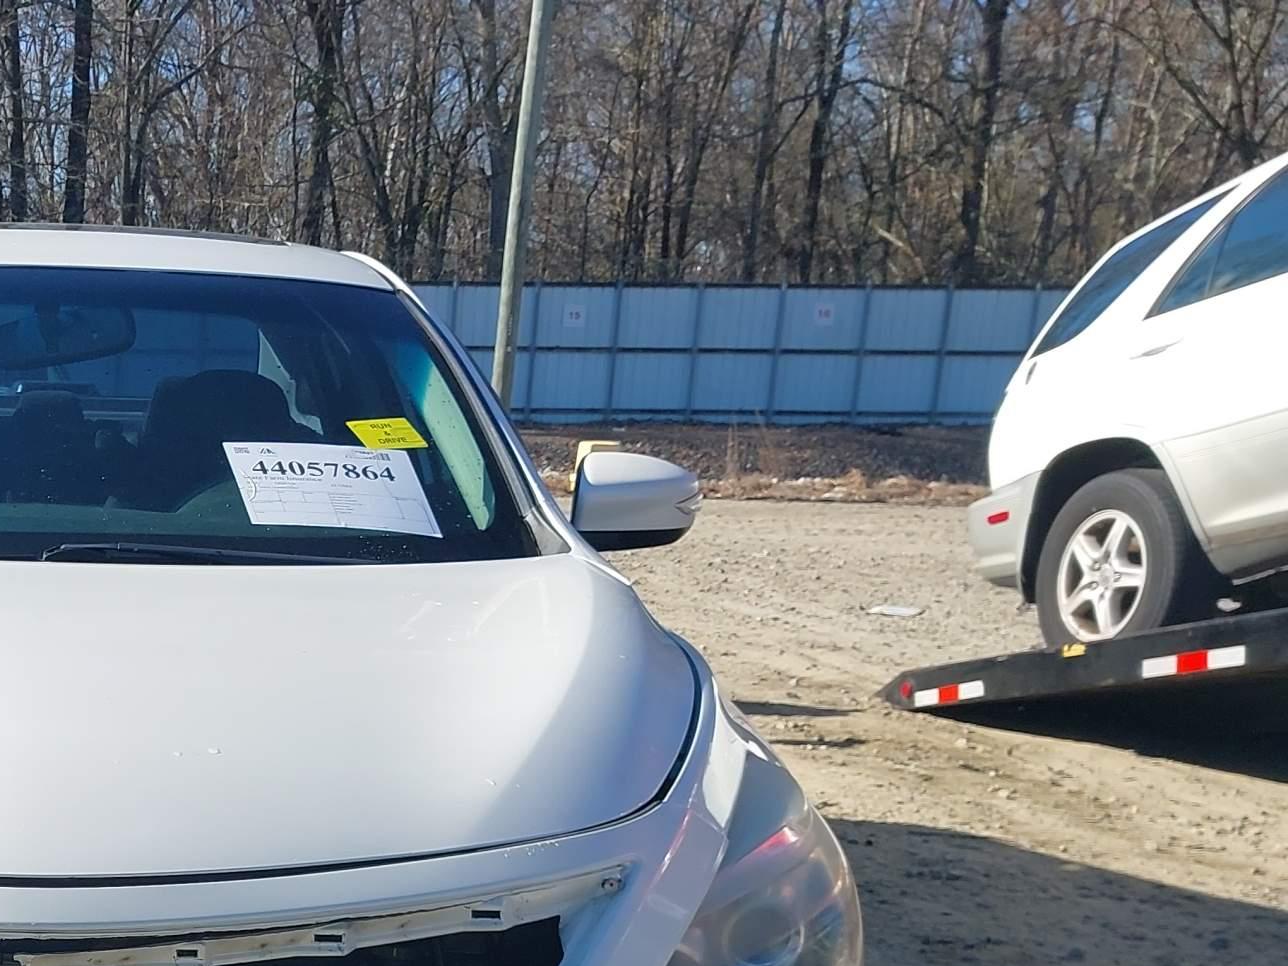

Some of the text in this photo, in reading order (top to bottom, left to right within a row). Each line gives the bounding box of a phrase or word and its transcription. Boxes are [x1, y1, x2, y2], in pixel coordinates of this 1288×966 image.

[568, 311, 581, 320] 15
[377, 437, 409, 445] DRIVE
[252, 460, 396, 482] 44057864
